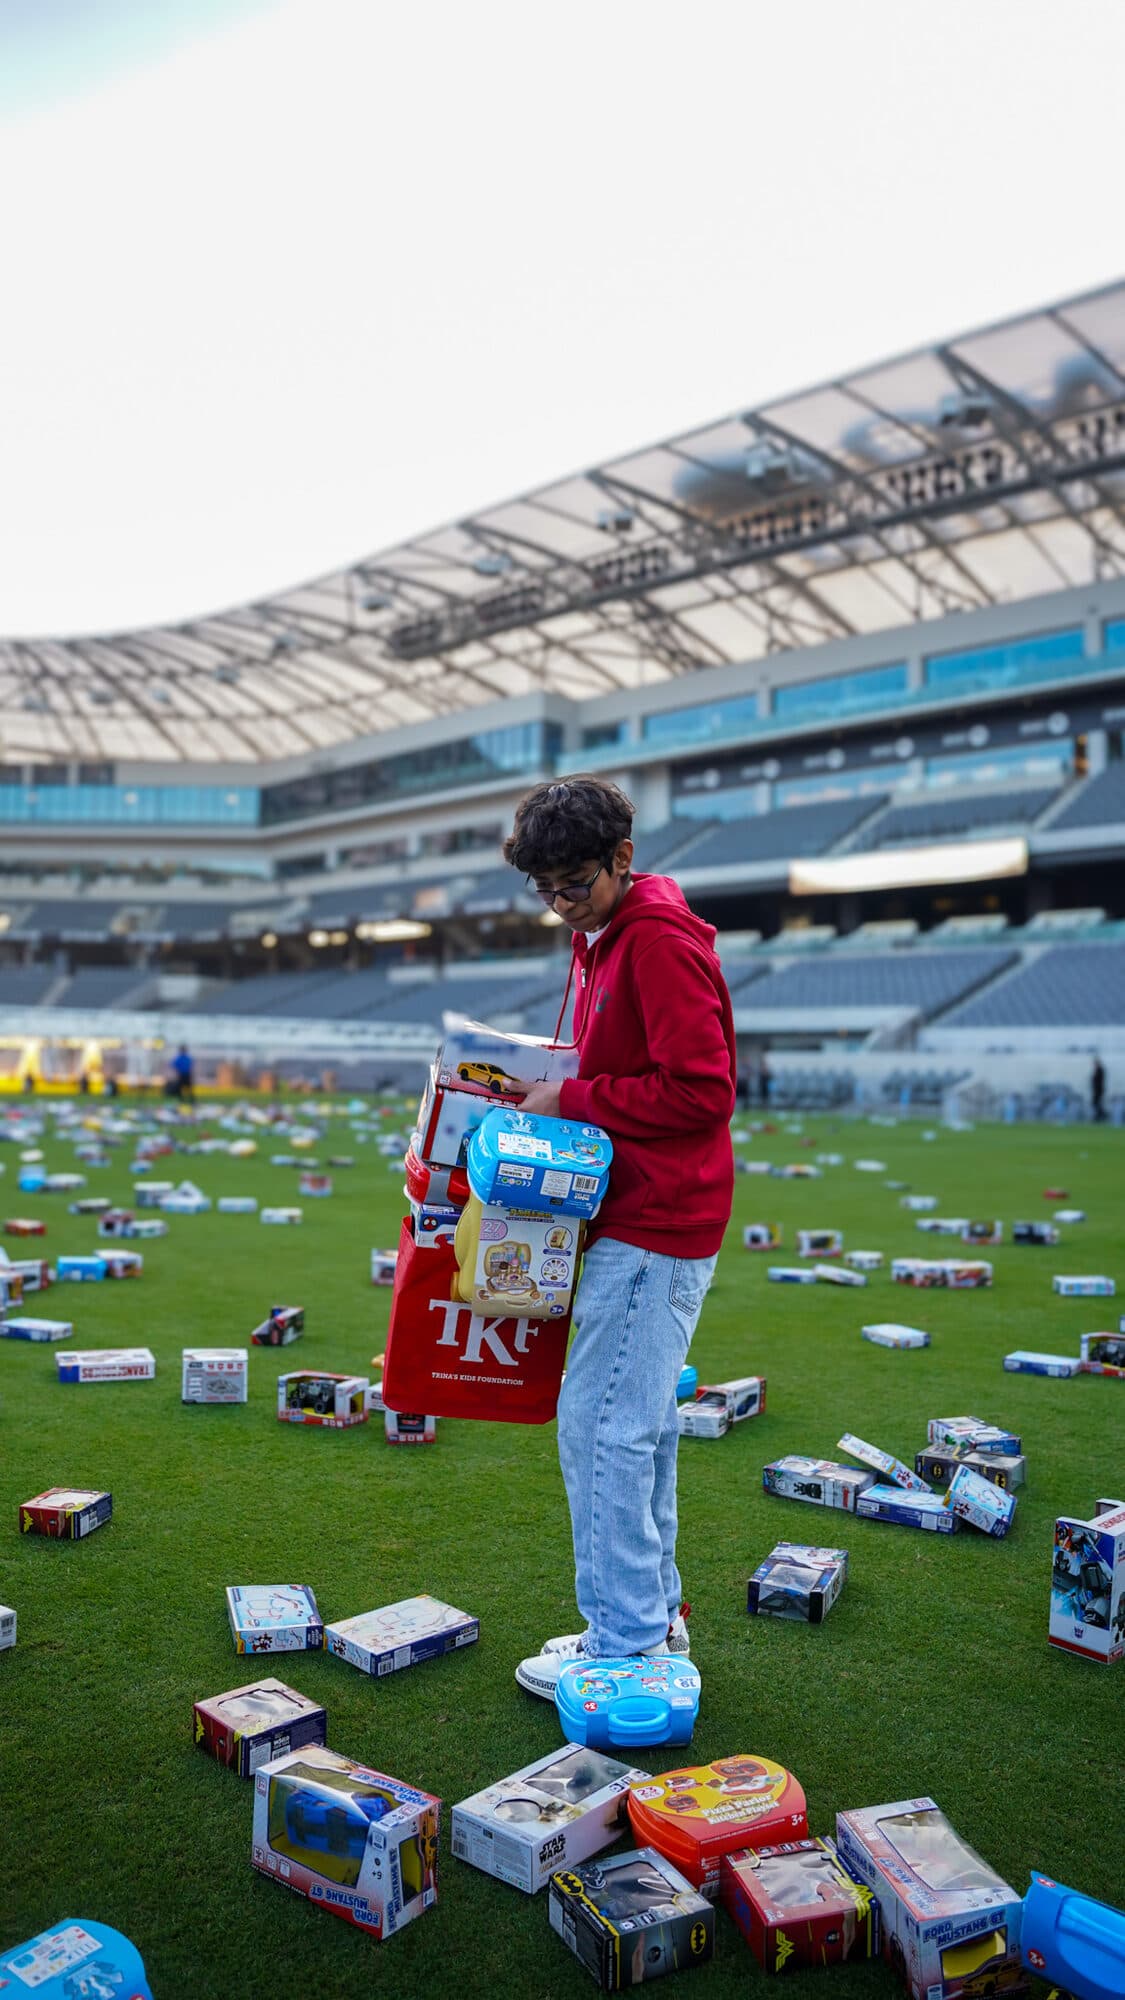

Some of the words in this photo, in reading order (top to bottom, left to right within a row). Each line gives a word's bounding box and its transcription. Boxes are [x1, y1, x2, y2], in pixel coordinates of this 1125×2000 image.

[484, 1221, 501, 1233] 27
[551, 1306, 563, 1314] 3+
[428, 1299, 539, 1366] TKF
[459, 1374, 477, 1382] KIDS
[477, 1376, 524, 1386] FOUNDATION
[791, 1814, 805, 1827] 3+
[542, 1833, 567, 1851] STAR
[539, 1841, 567, 1865] WARS
[311, 1883, 324, 1898] GT
[390, 1862, 402, 1913] MUSTANG
[326, 1889, 370, 1910] MUSTANG
[354, 1908, 380, 1925] FORD
[923, 1921, 953, 1942] FORD
[936, 1917, 988, 1948] MUSTANG
[990, 1911, 1004, 1925] GT
